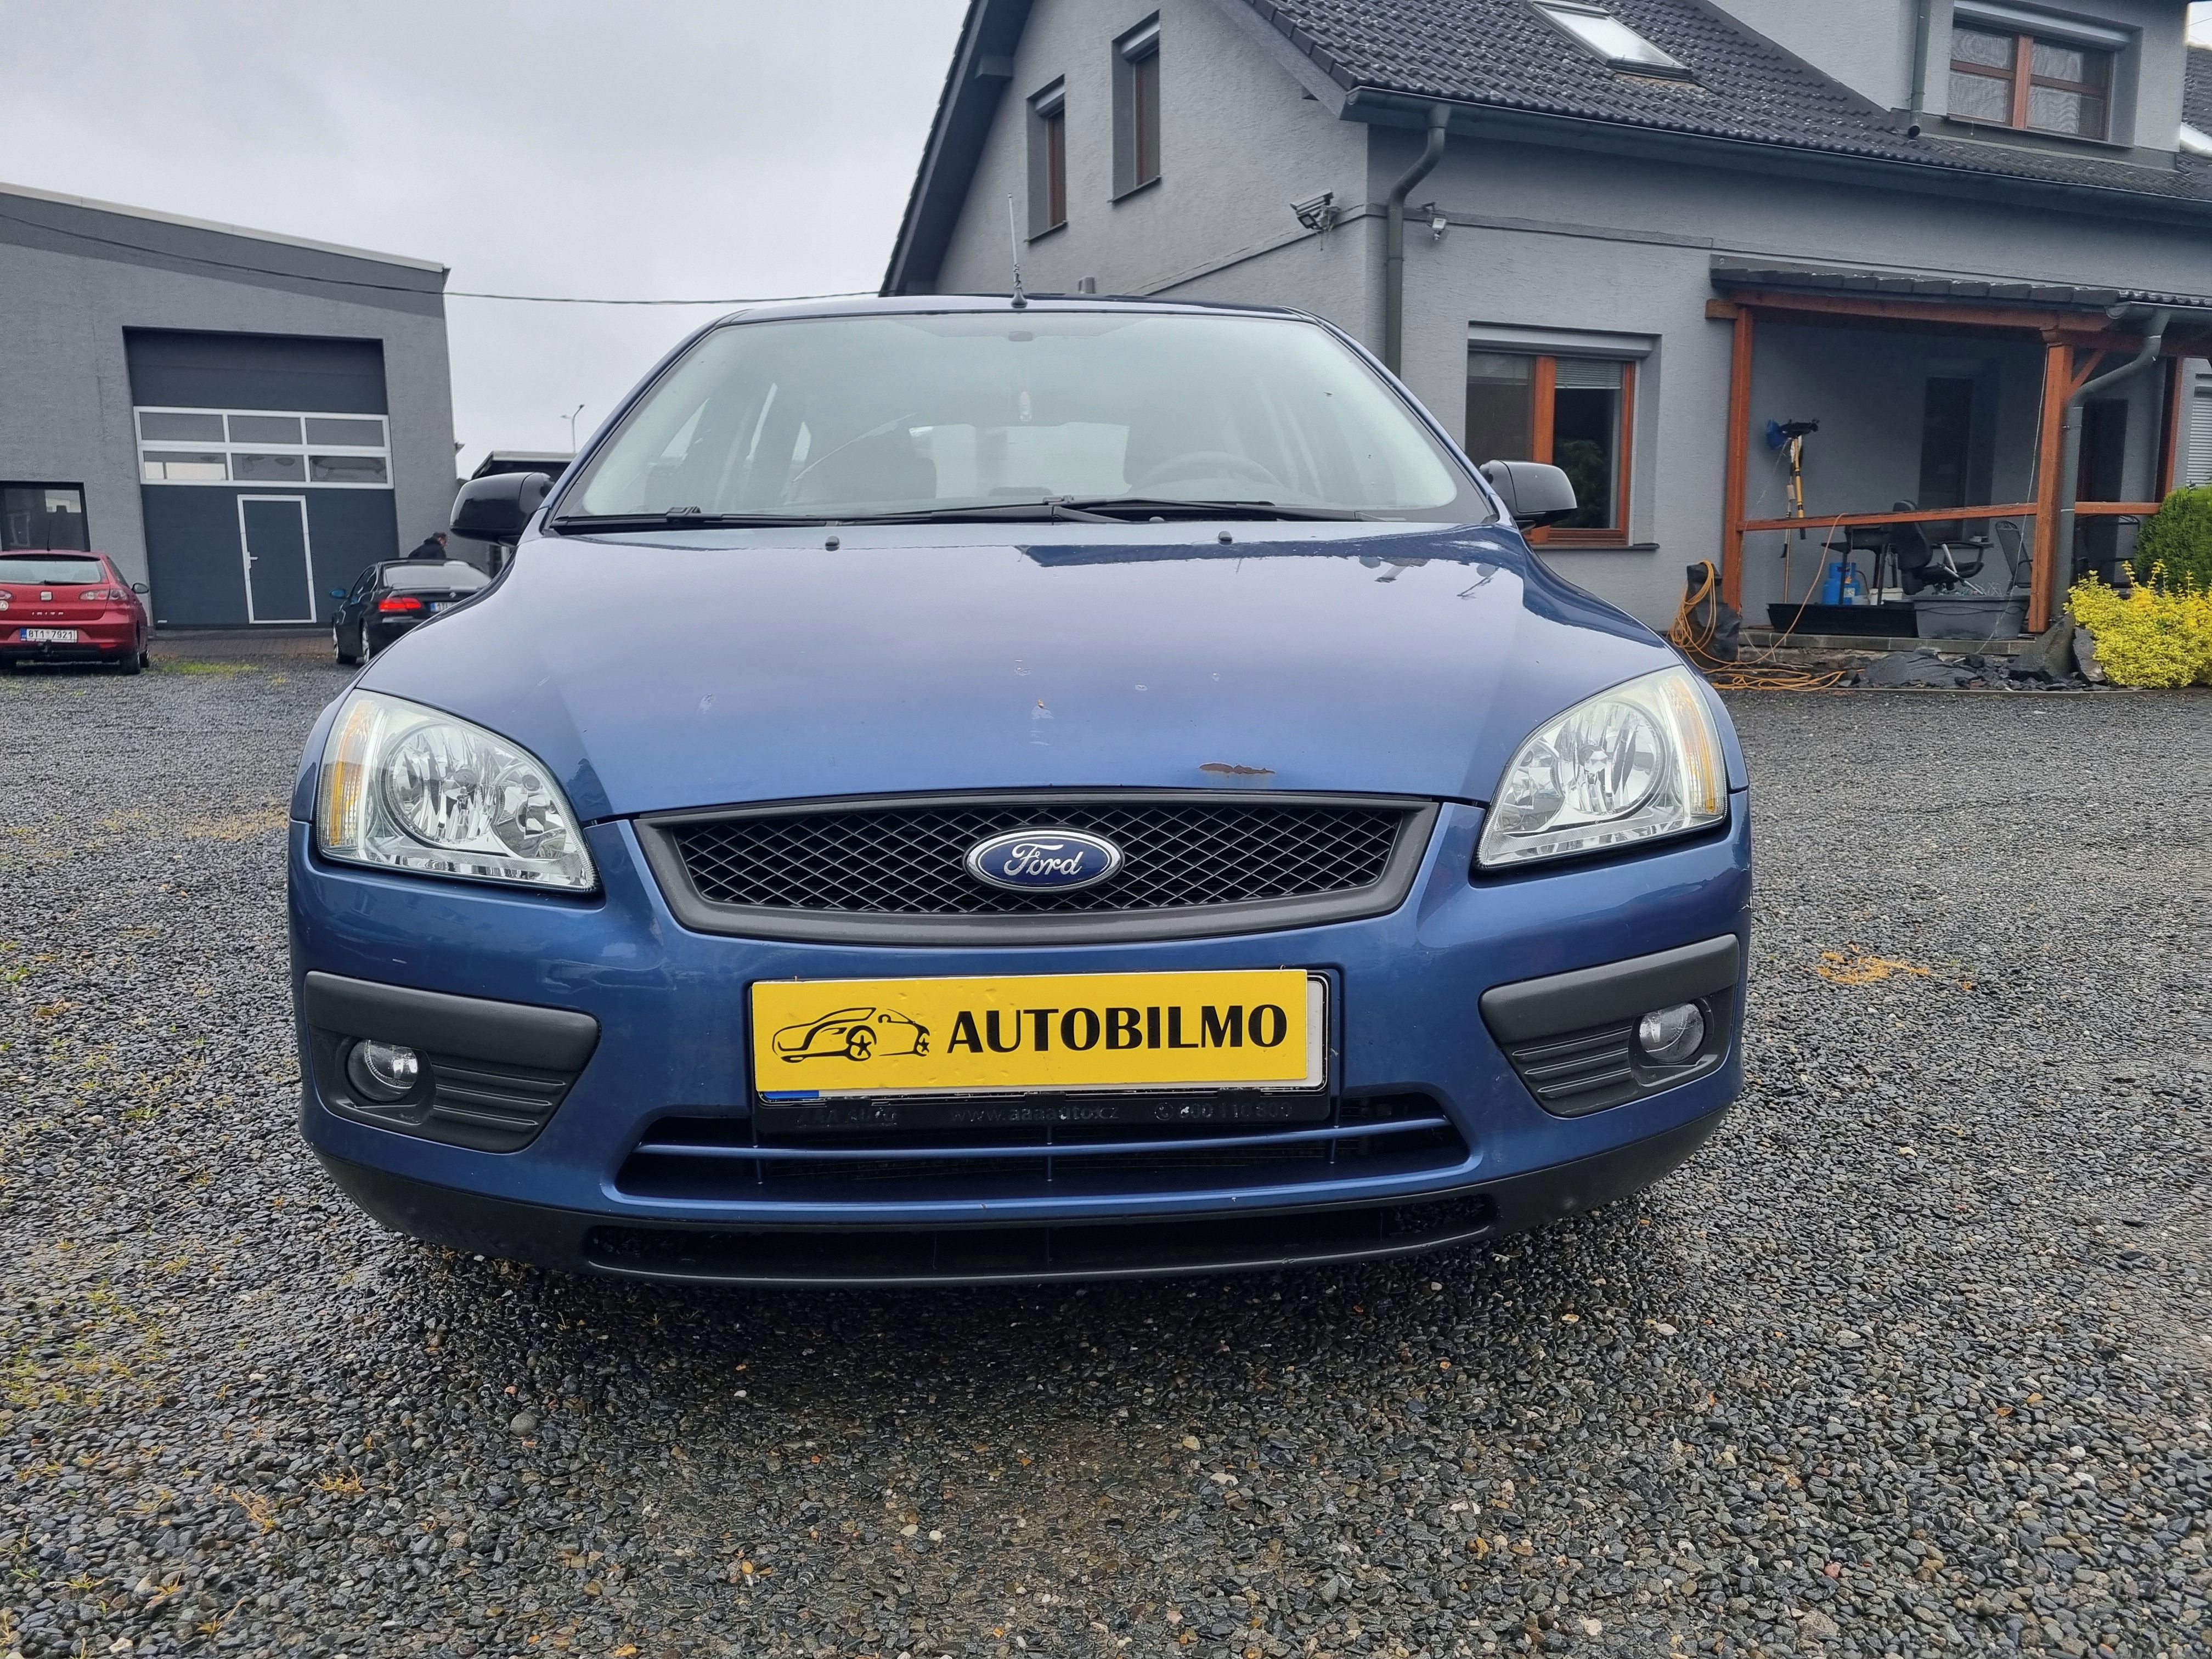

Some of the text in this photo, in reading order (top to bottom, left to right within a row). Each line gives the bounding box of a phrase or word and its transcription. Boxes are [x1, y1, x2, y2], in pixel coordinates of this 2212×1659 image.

[52, 630, 72, 640] 7921
[1003, 843, 1084, 876] Ford
[946, 1004, 1288, 1053] AUTOBILMO
